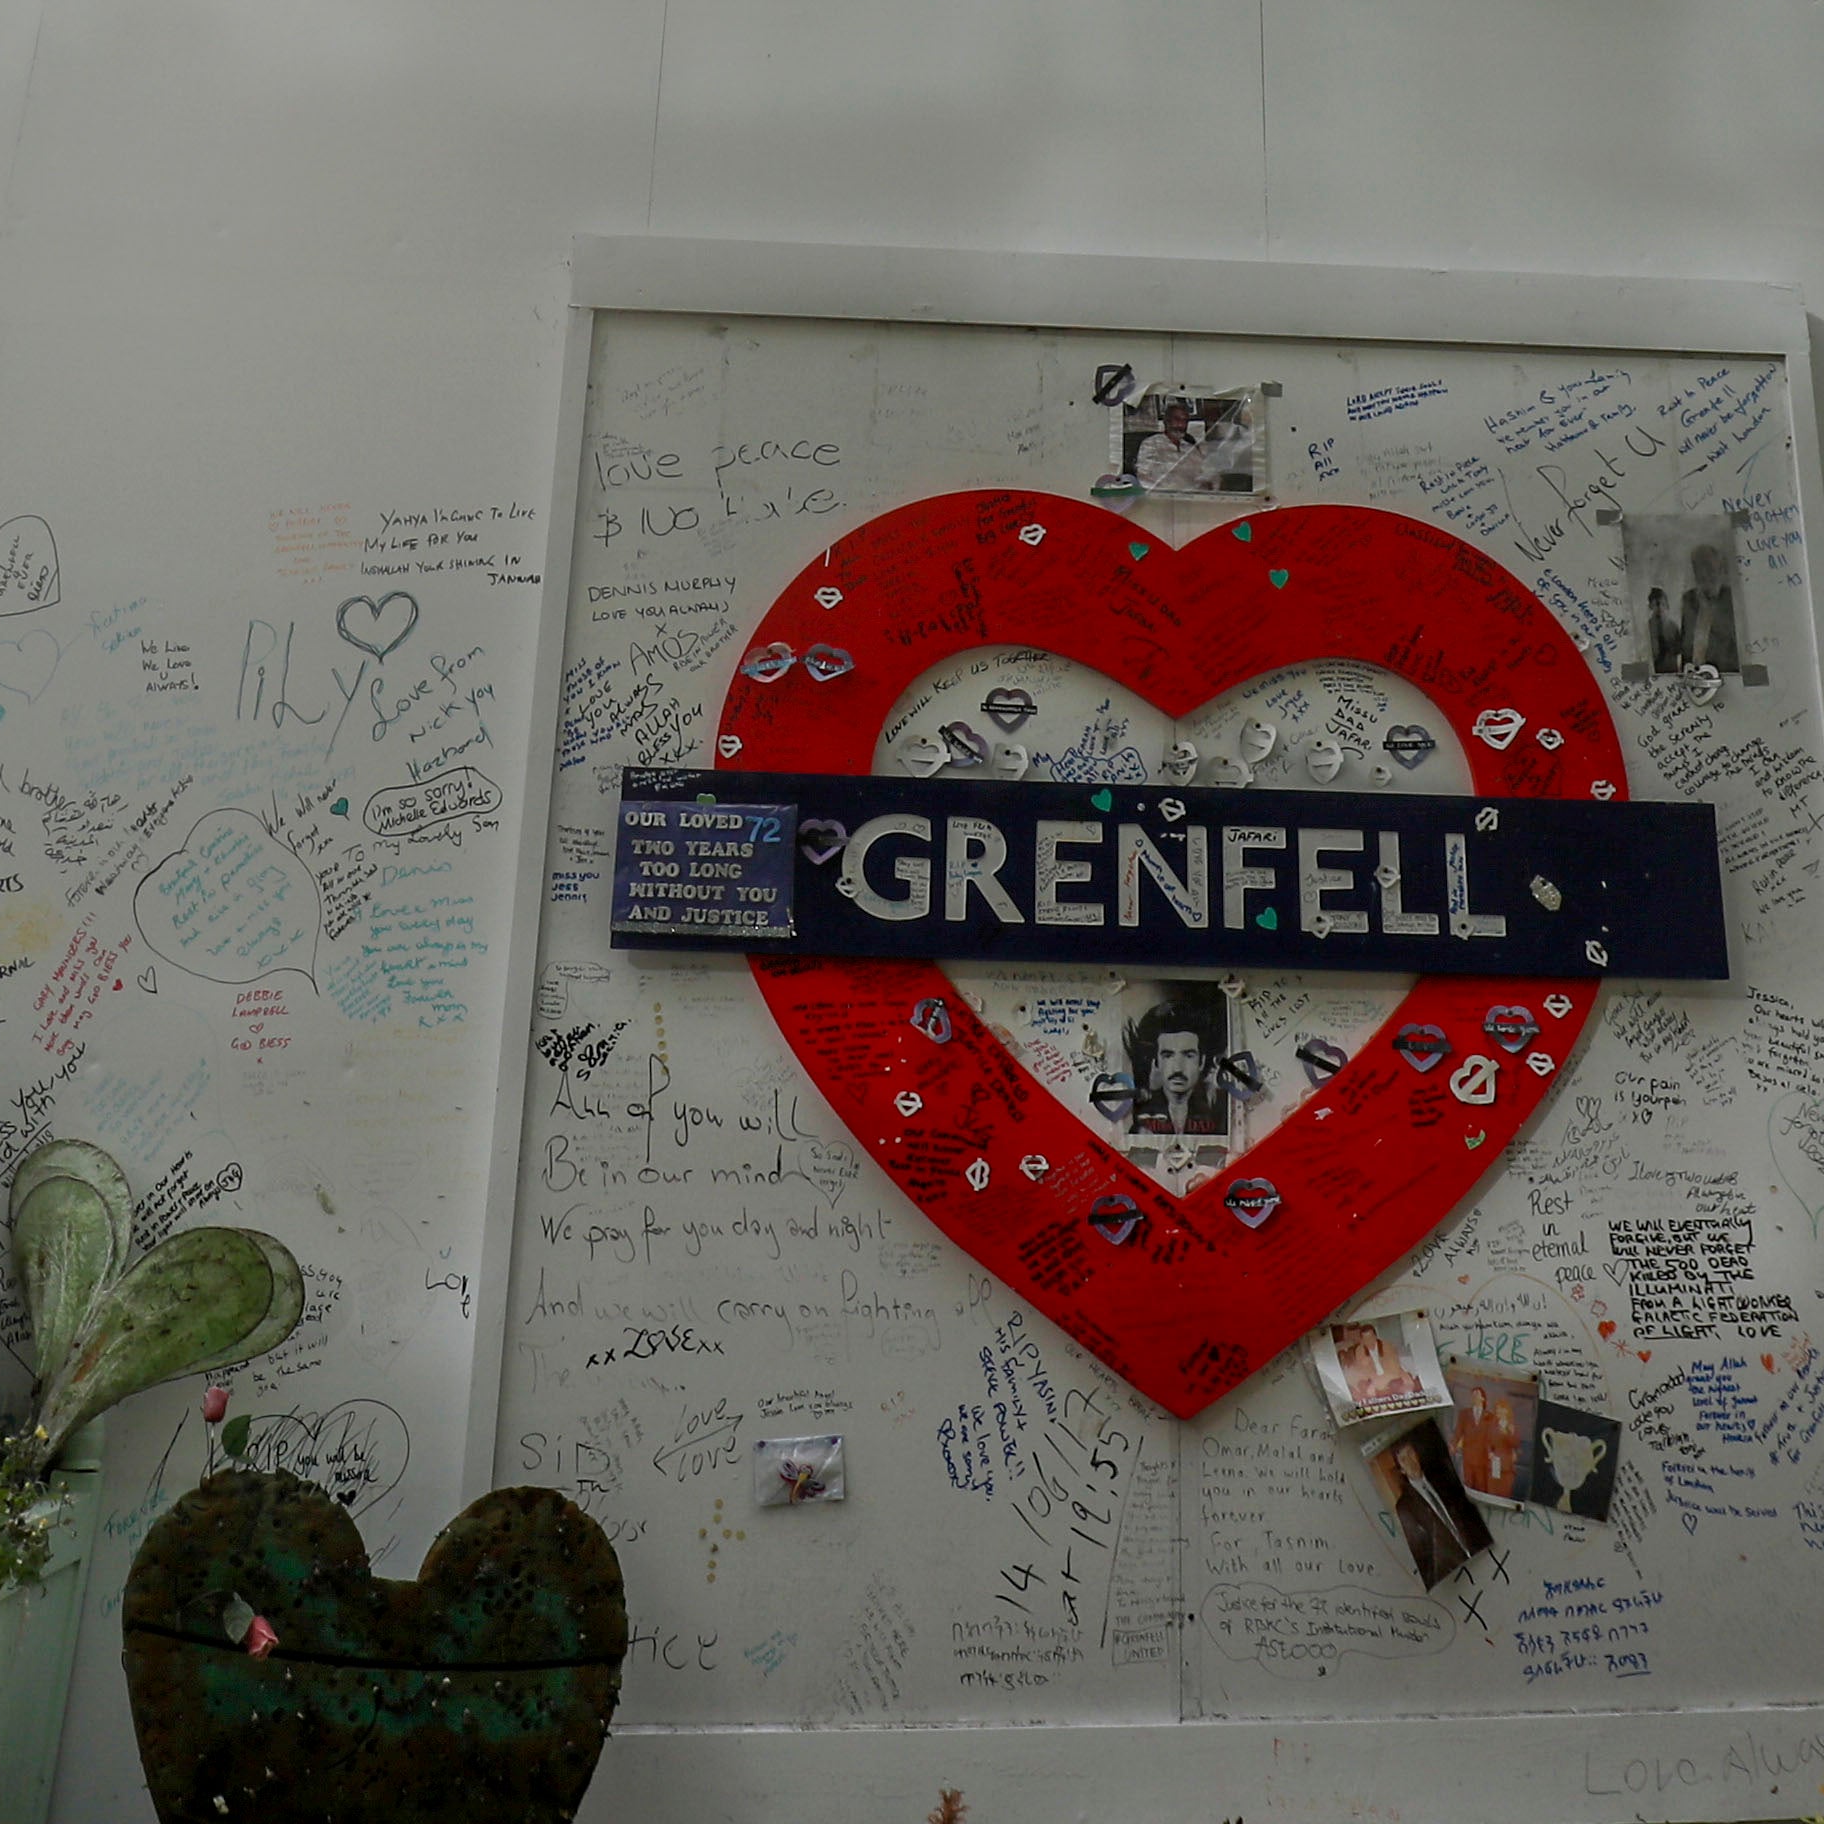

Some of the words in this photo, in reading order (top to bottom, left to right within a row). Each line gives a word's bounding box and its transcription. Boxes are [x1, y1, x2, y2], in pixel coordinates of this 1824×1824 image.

[1626, 426, 1666, 457] U
[595, 449, 684, 491] love
[1537, 449, 1625, 538] forget
[1515, 518, 1564, 563] Never
[588, 582, 657, 602] DENNIS
[665, 577, 735, 594] MURPHY
[592, 609, 627, 621] LOVE
[635, 607, 665, 619] YOU
[630, 630, 699, 676] AMOS
[371, 678, 433, 742] Love
[431, 647, 484, 694] from
[1335, 708, 1365, 731] DAD
[19, 768, 76, 811] brother
[625, 812, 666, 826] OUR
[680, 813, 743, 830] LOVED
[745, 817, 781, 842] 72
[632, 840, 674, 855] TWO
[686, 841, 754, 857] YEARS
[640, 862, 680, 877] TOO
[689, 863, 742, 878] LONG
[841, 813, 1506, 937] GRENFELL
[629, 882, 724, 900] WITHOUT
[737, 887, 777, 902] YOU
[629, 905, 671, 921] AND
[681, 908, 769, 926] JUSTICE
[237, 991, 283, 1005] DEBBIE
[675, 1101, 723, 1147] you
[739, 1088, 818, 1142] will
[1528, 1188, 1574, 1216] Rest
[541, 1204, 589, 1244] We
[585, 1226, 635, 1263] pray
[643, 1205, 671, 1264] for
[683, 1223, 723, 1256] you
[732, 1207, 781, 1260] day
[789, 1206, 818, 1239] and
[828, 1208, 891, 1252] night
[1543, 1224, 1559, 1236] in
[1532, 1231, 1588, 1262] eternal
[1646, 1245, 1695, 1256] NEVER
[1701, 1244, 1756, 1255] FORGET
[1627, 1259, 1660, 1269] THE
[1666, 1259, 1698, 1272] 500
[1709, 1257, 1748, 1268] DEAD
[1556, 1265, 1596, 1291] peace
[1630, 1284, 1734, 1296] ILLUMINATI
[1632, 1310, 1703, 1323] GALACTIC
[1710, 1310, 1799, 1322] FEDERATION
[1235, 1408, 1277, 1433] Dear
[1201, 1510, 1264, 1529] forever
